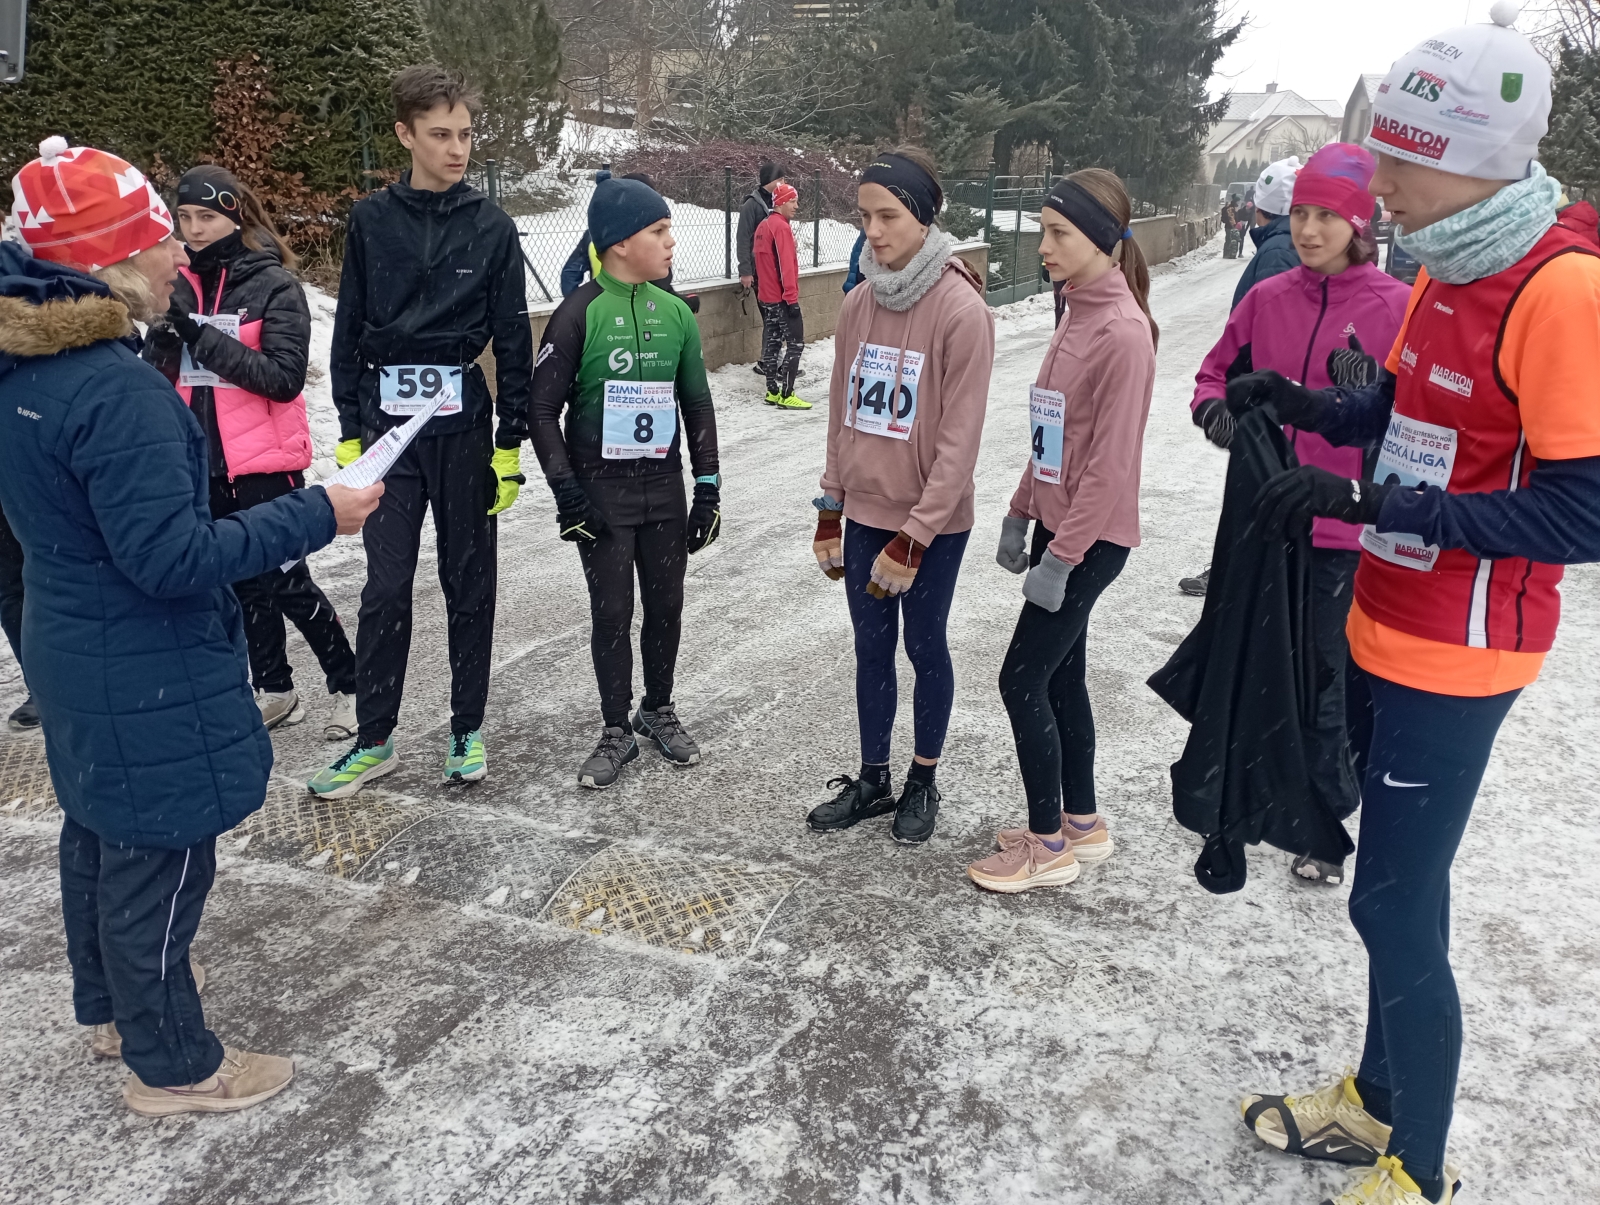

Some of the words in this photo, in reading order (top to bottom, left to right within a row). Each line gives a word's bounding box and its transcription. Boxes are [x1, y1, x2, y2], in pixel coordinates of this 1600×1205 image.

[1400, 71, 1444, 102] LES
[1373, 112, 1450, 149] MARATON
[1416, 145, 1441, 157] stav
[635, 352, 658, 360] SPORT
[396, 367, 443, 399] 59
[1431, 363, 1474, 389] MARATON
[608, 384, 643, 395] ZIMNÍ
[608, 395, 656, 404] BĚŽECKÁ
[1043, 407, 1062, 420] LIGA
[633, 412, 654, 443] 8
[1400, 432, 1451, 451] 2025-2026
[1409, 449, 1447, 470] LIGA
[1395, 542, 1434, 558] MARATON
